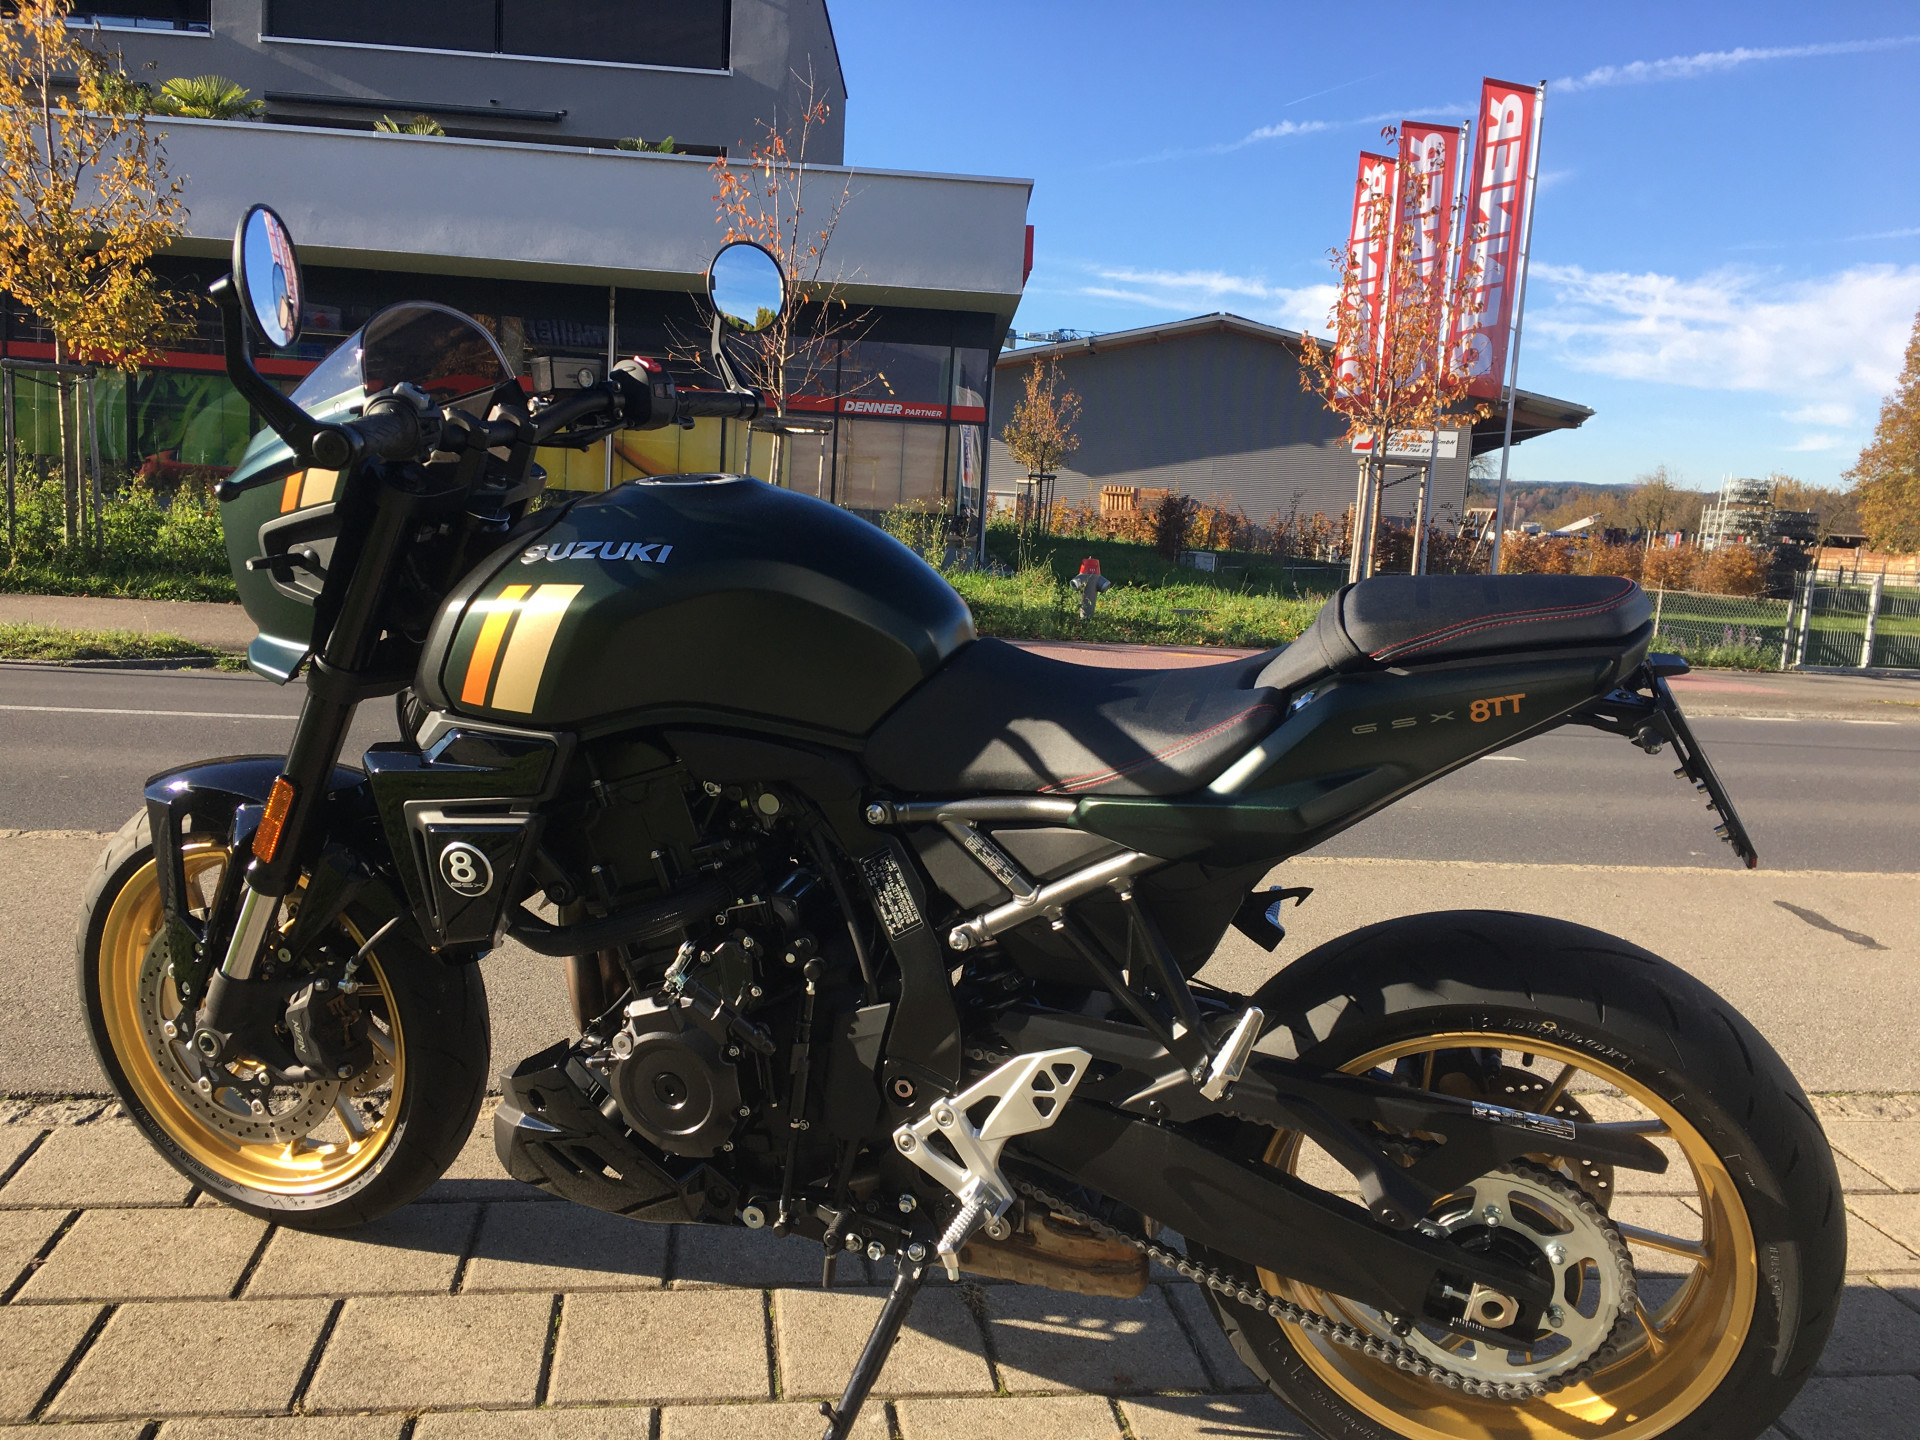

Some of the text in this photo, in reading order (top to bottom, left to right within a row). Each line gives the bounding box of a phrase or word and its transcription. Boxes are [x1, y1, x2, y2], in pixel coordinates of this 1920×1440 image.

[844, 400, 942, 418] DENNER PARTNER
[520, 541, 674, 565] SUZUKI
[1470, 693, 1526, 723] 8TT
[449, 851, 476, 882] 8
